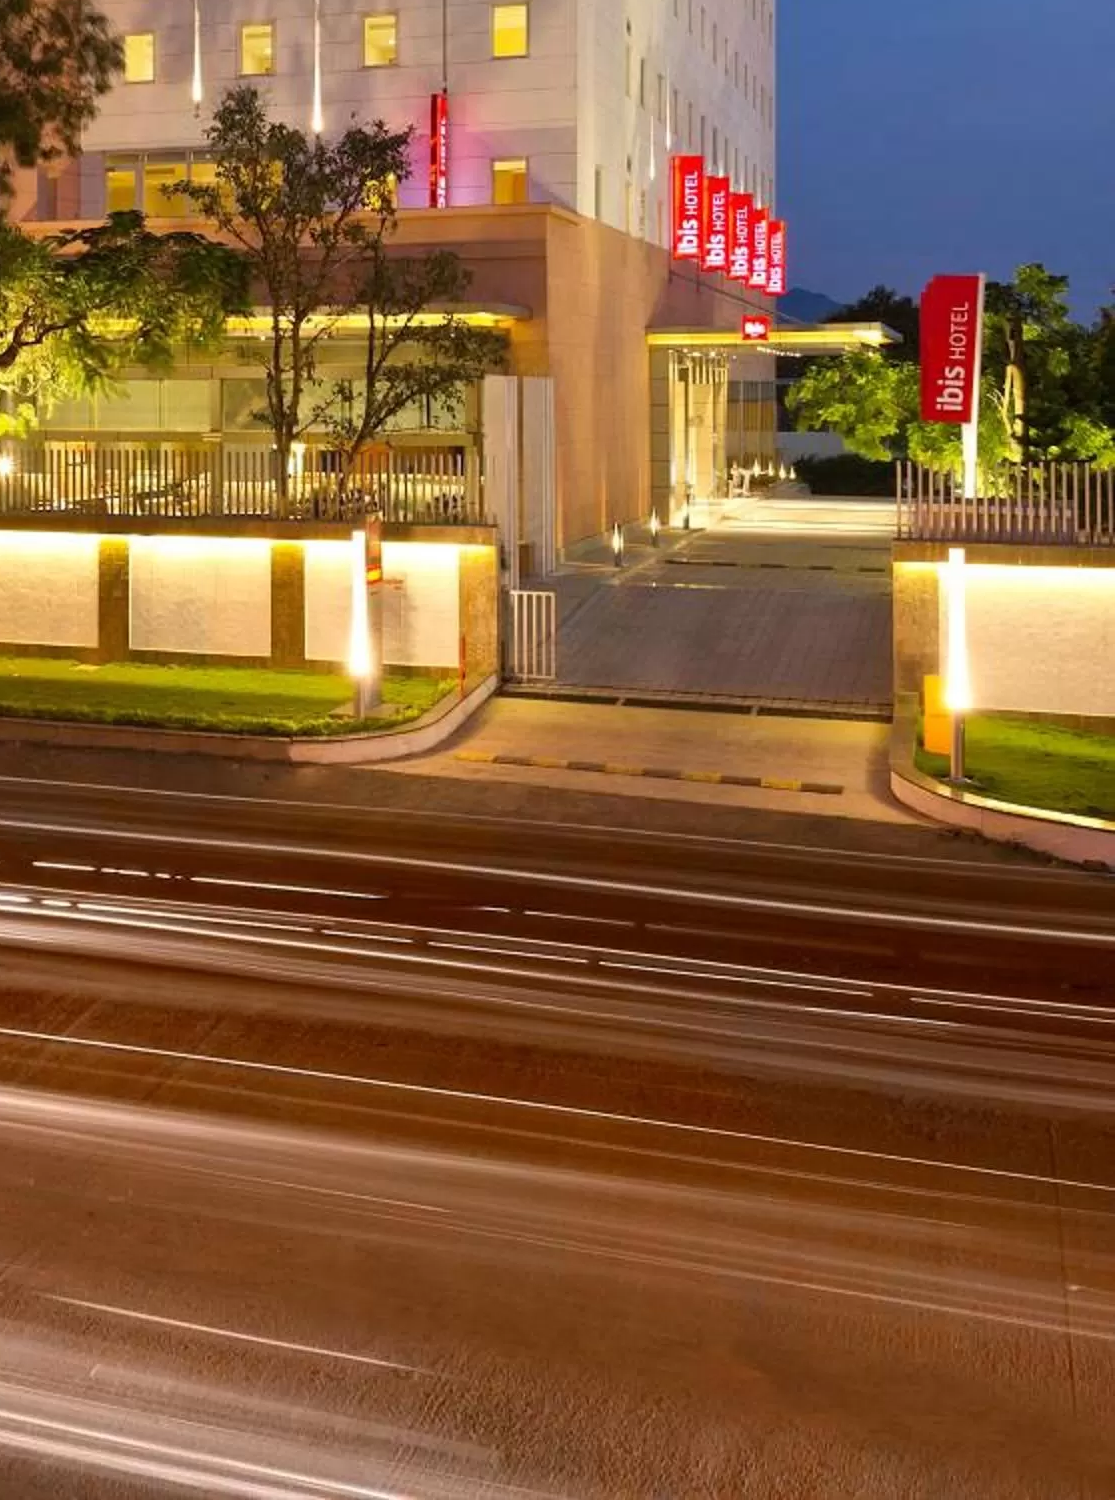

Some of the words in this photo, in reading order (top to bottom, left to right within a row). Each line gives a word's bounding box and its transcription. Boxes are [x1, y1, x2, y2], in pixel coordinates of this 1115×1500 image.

[685, 171, 698, 215] HOTEL
[713, 190, 725, 231] HOTEL
[676, 219, 698, 253] ibis
[736, 205, 748, 243] HOTEL
[949, 301, 969, 360] HOTEL
[936, 366, 966, 411] ibis
